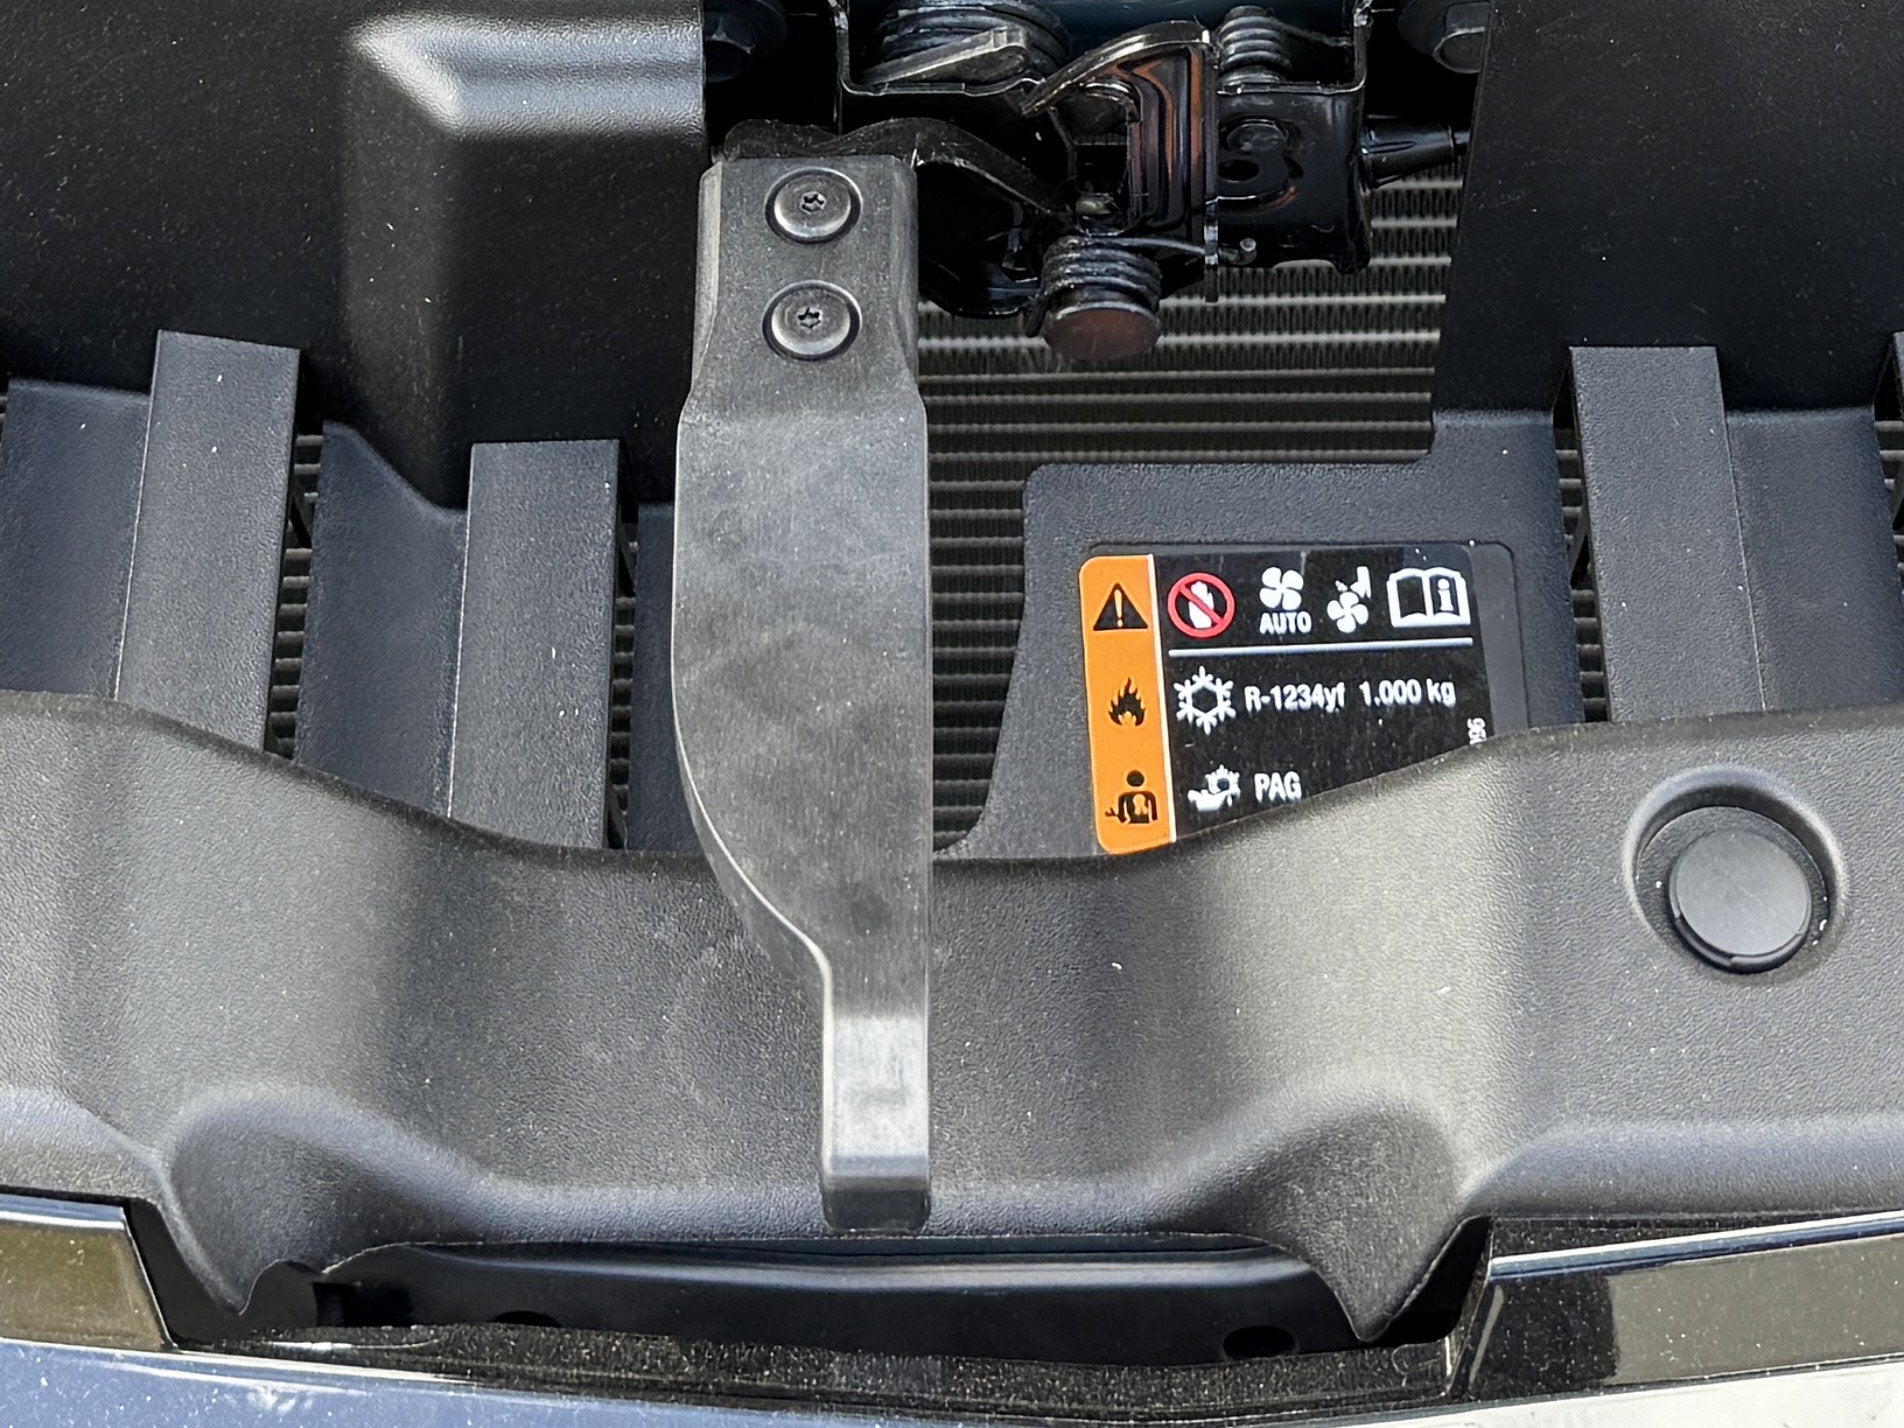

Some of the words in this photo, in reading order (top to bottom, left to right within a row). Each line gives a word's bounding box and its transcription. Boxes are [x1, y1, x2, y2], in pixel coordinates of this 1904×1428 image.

[1259, 610, 1313, 635] AUTO
[1244, 682, 1346, 713] R-1234yf
[1359, 678, 1422, 708] 1.000
[1426, 678, 1457, 707] kg
[1253, 770, 1303, 804] PAG
